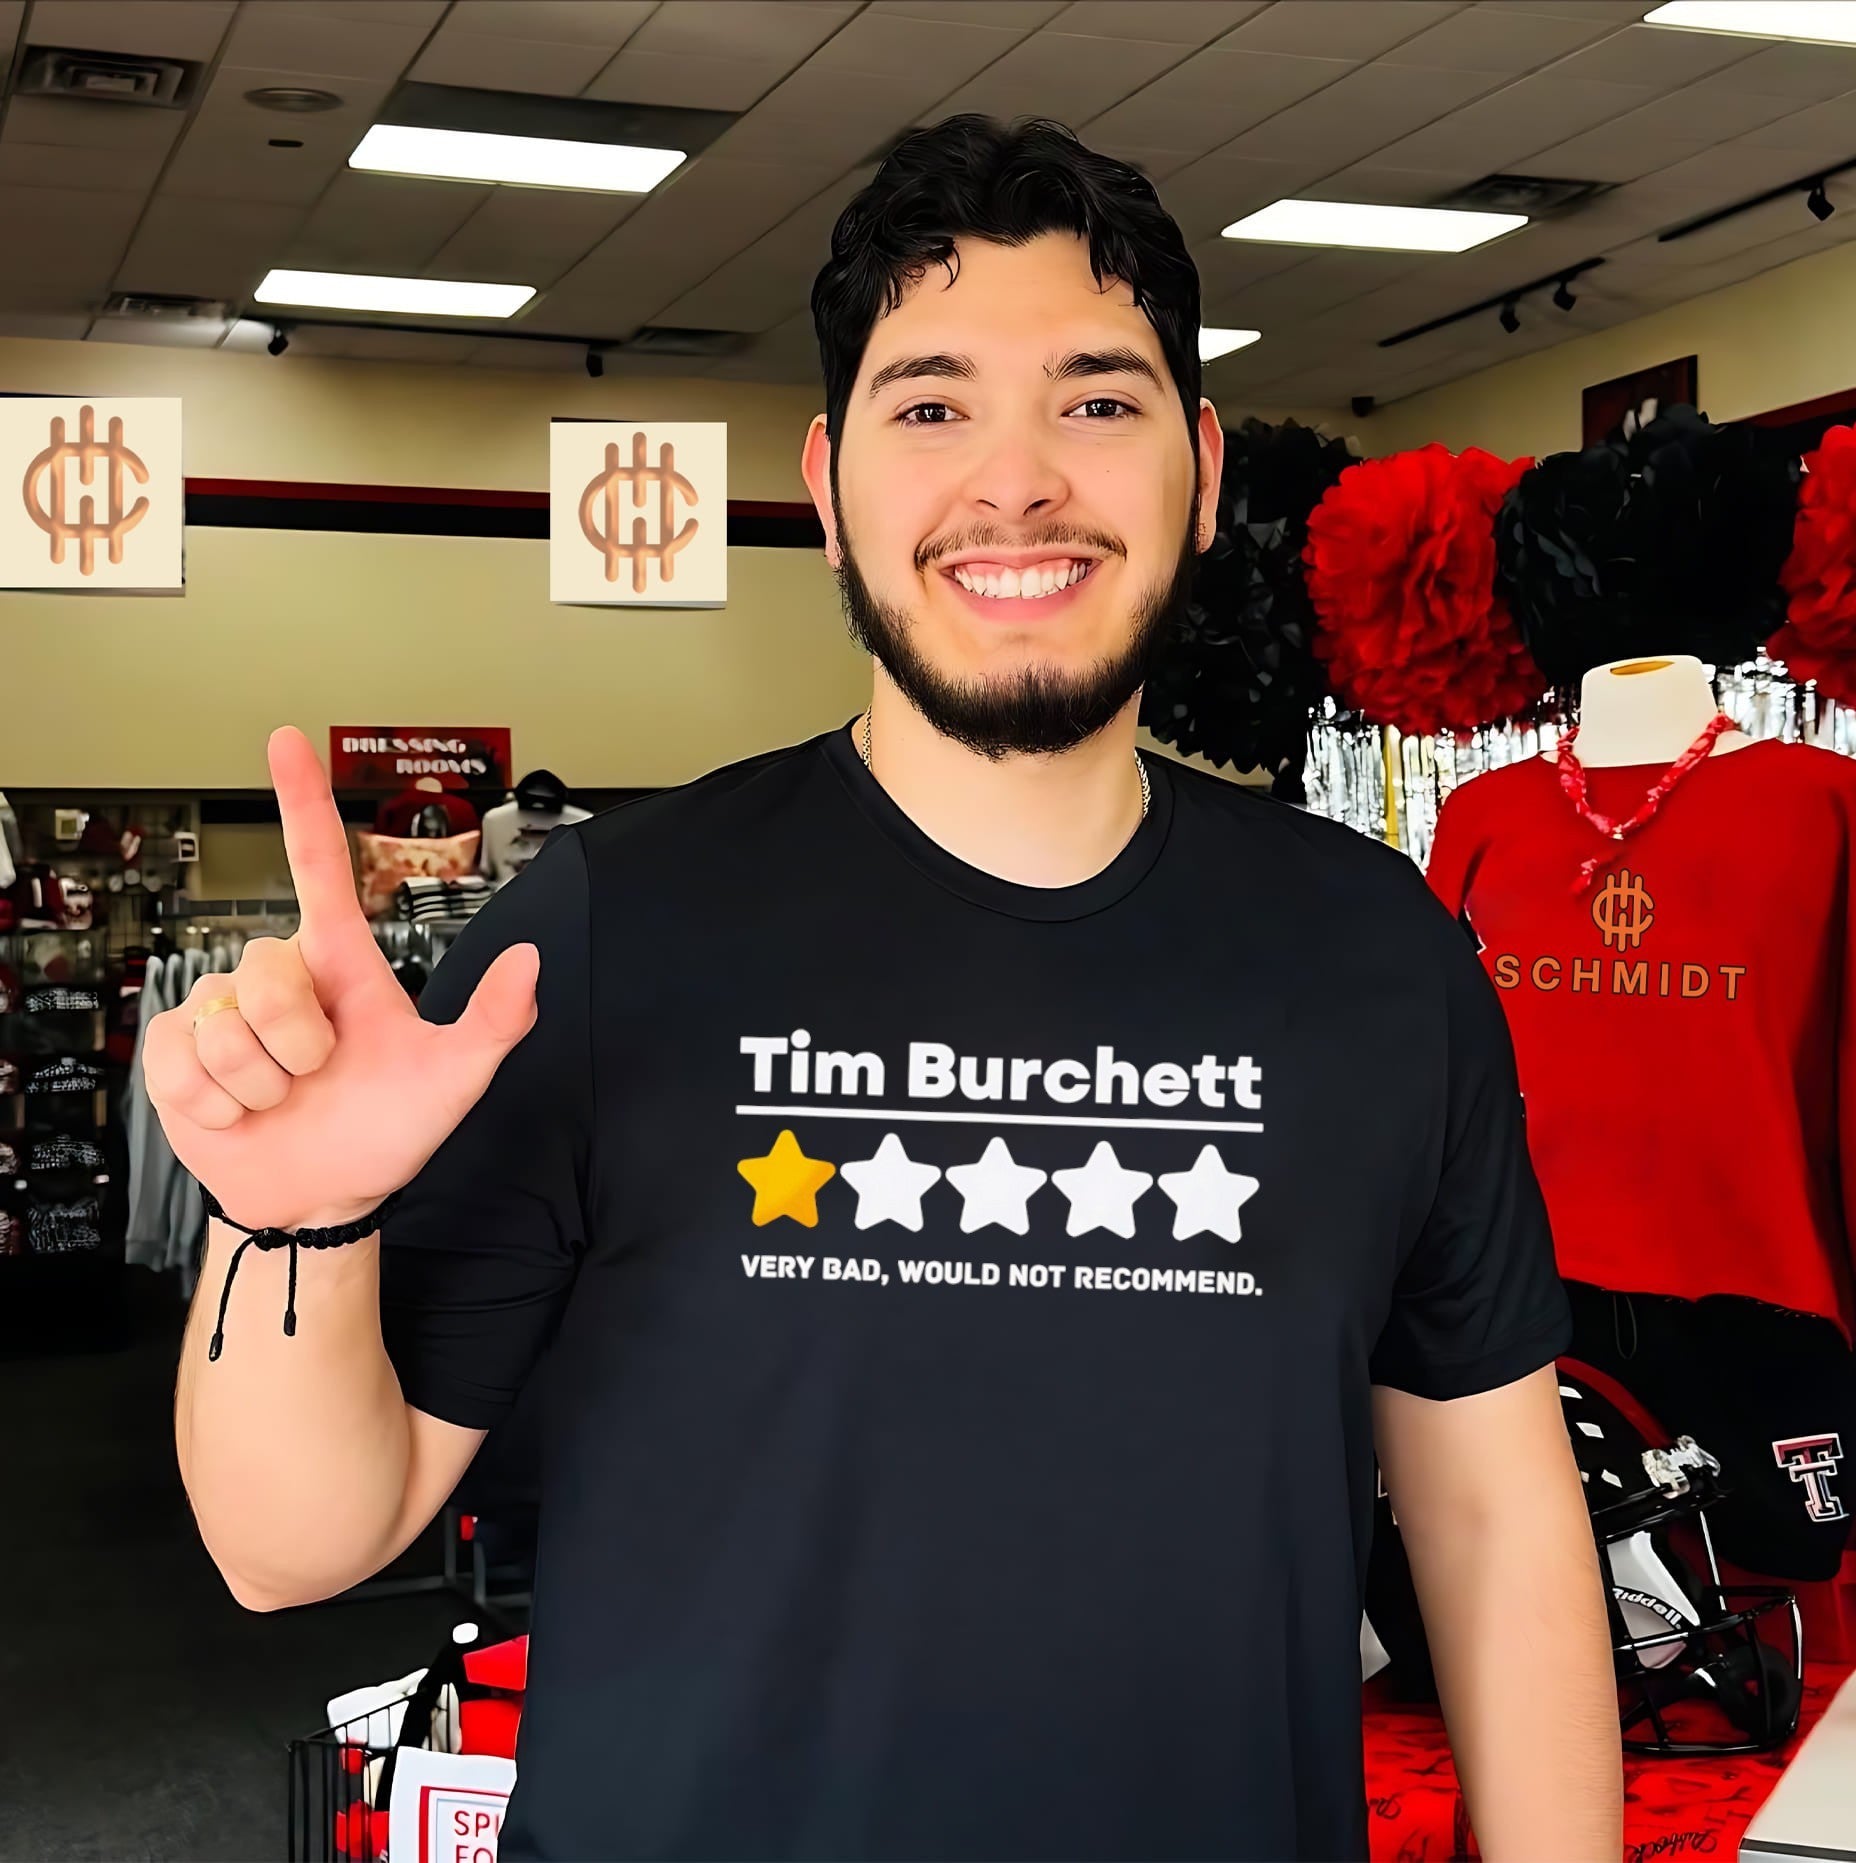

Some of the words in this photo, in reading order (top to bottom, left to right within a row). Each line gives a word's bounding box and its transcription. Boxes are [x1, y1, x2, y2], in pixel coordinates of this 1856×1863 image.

[1494, 955, 1747, 999] SCHMIDT
[740, 1029, 885, 1096] Tim
[908, 1042, 1262, 1110] Burchett
[741, 1254, 816, 1279] VERY
[822, 1256, 890, 1286] BAD,
[898, 1260, 1000, 1286] WOULD
[1009, 1264, 1067, 1288] NOT
[1074, 1265, 1263, 1297] RECOMMEND.
